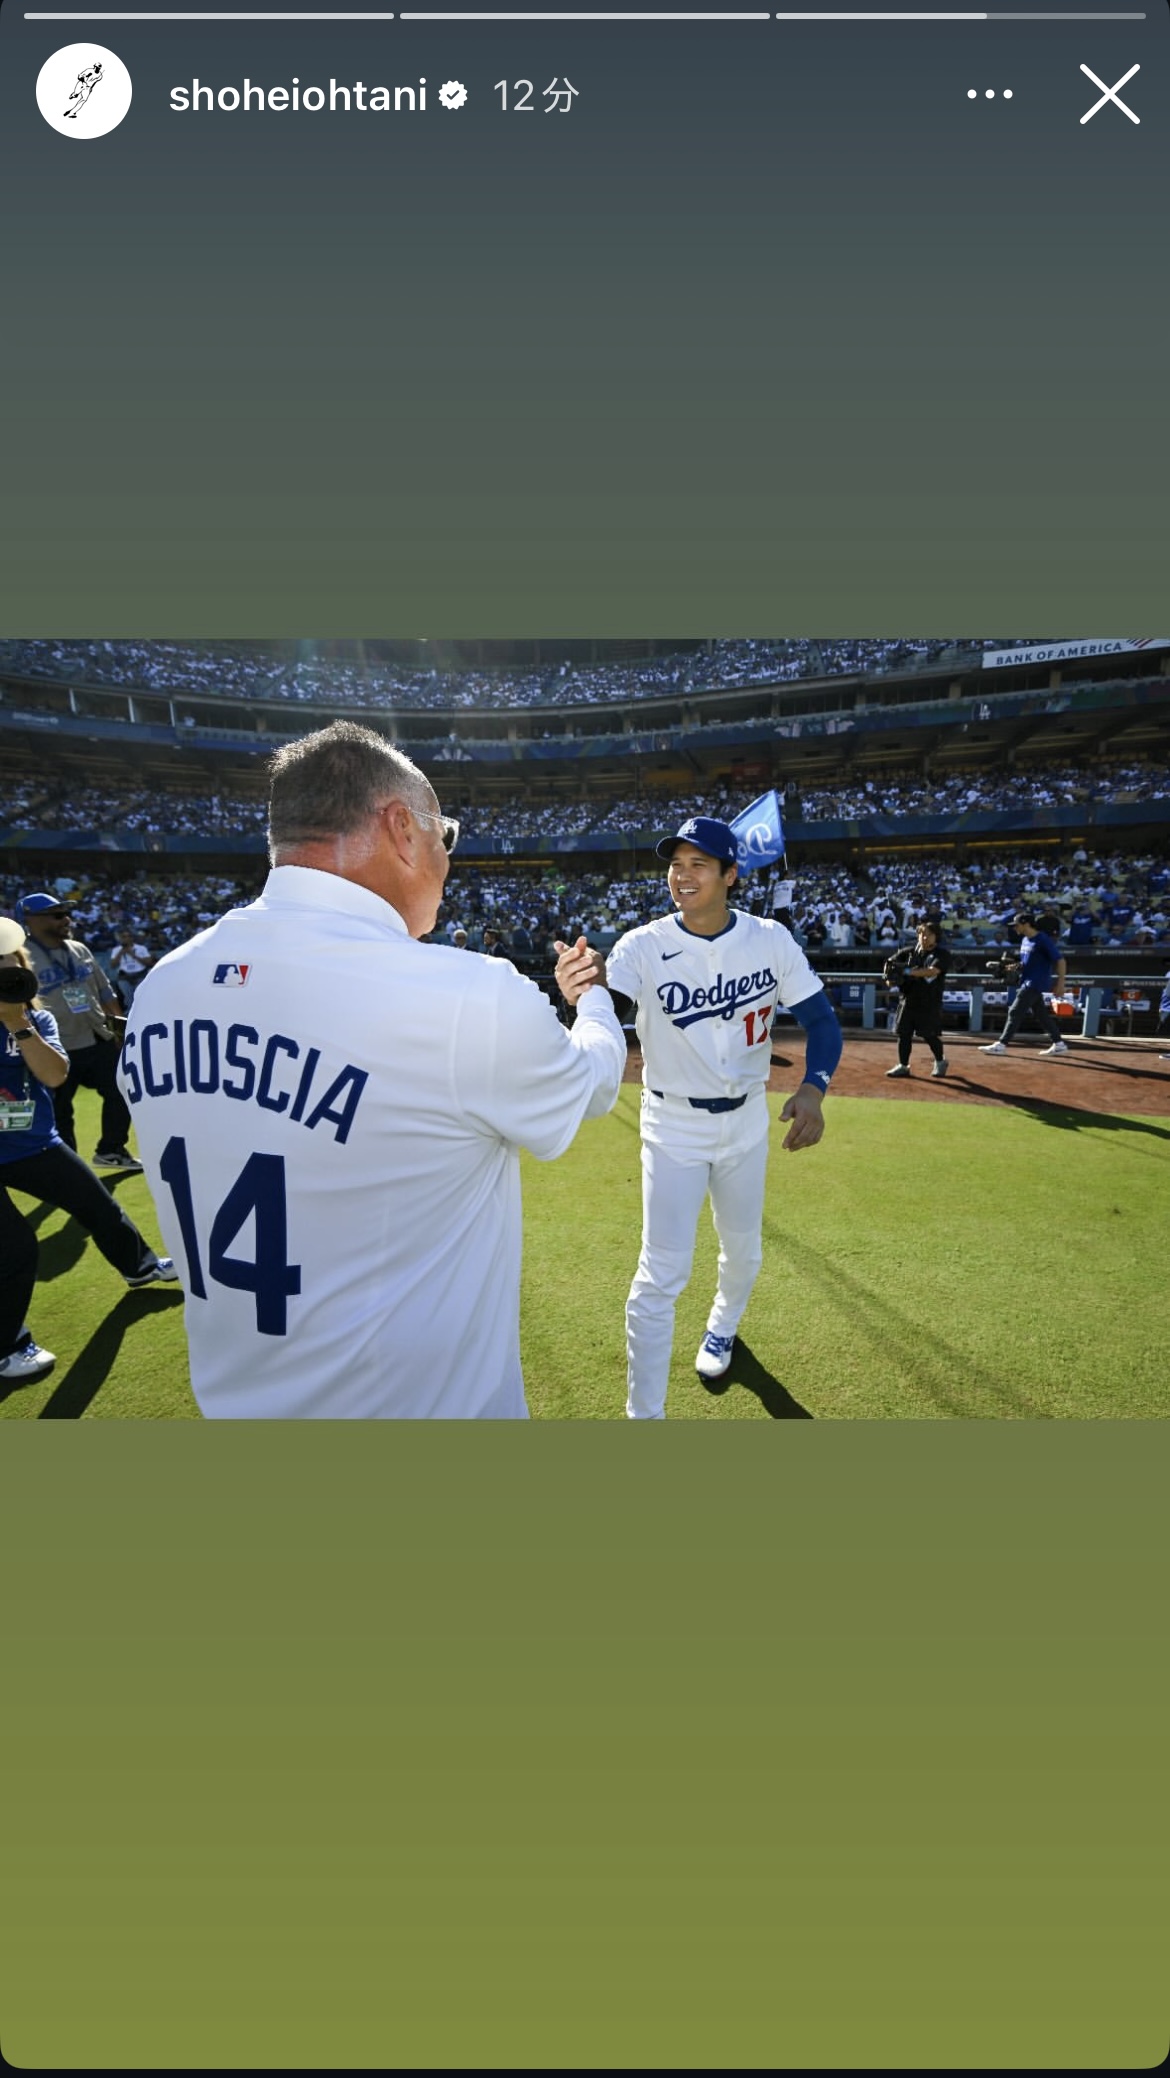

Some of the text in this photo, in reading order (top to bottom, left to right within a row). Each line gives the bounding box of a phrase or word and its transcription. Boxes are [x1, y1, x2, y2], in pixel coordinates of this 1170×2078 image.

[995, 642, 1123, 665] BANK OF AMERICA
[657, 968, 778, 1030] Dodgers
[121, 1018, 369, 1145] SCIOSCIA
[159, 1136, 302, 1336] 14
